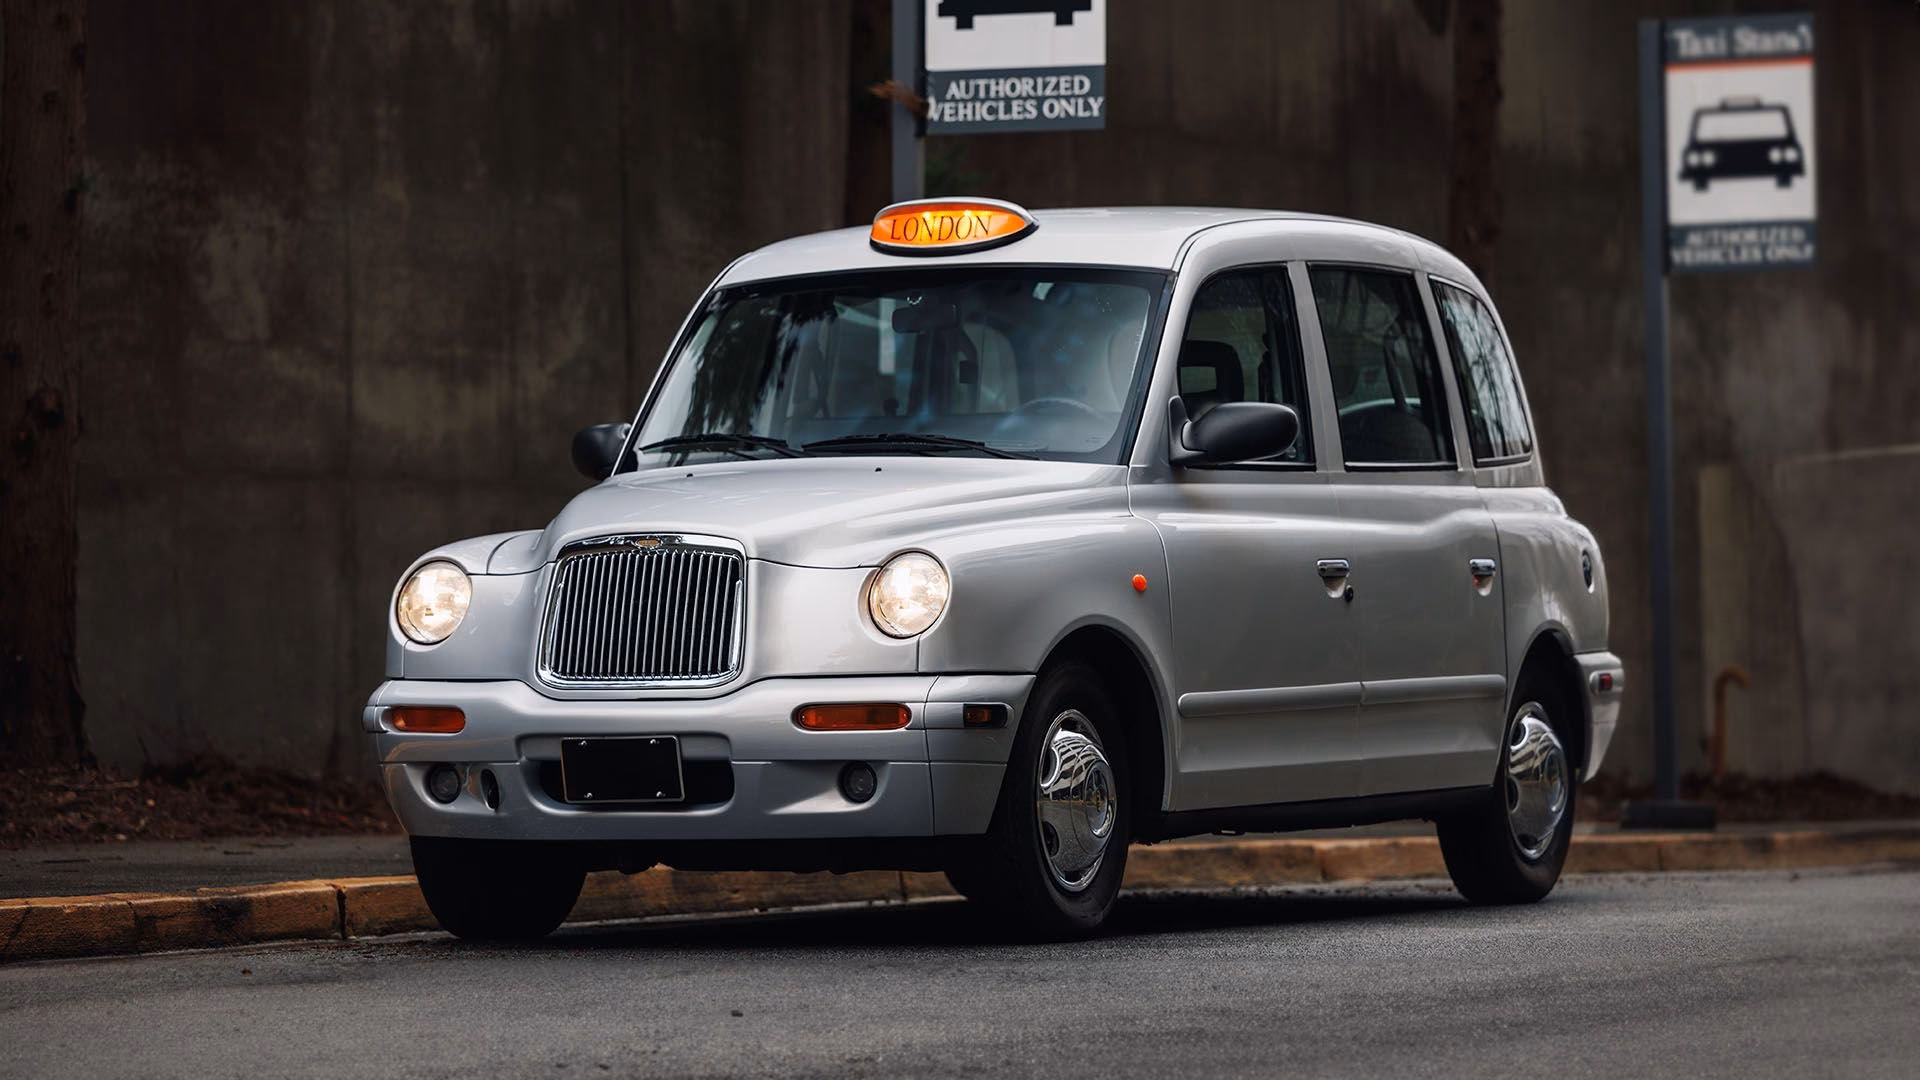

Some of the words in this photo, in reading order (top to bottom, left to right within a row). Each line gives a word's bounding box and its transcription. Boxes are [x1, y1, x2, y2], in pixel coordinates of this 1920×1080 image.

[1671, 28, 1728, 57] Taxi
[945, 74, 1091, 100] AUTHORIZED
[927, 97, 1037, 122] VEHICLES
[1042, 96, 1104, 119] ONLY
[890, 214, 992, 242] LONDON
[1685, 226, 1806, 247] AUTHORIZED
[1671, 246, 1763, 265] VEHICLES
[1766, 243, 1814, 261] ONLY
